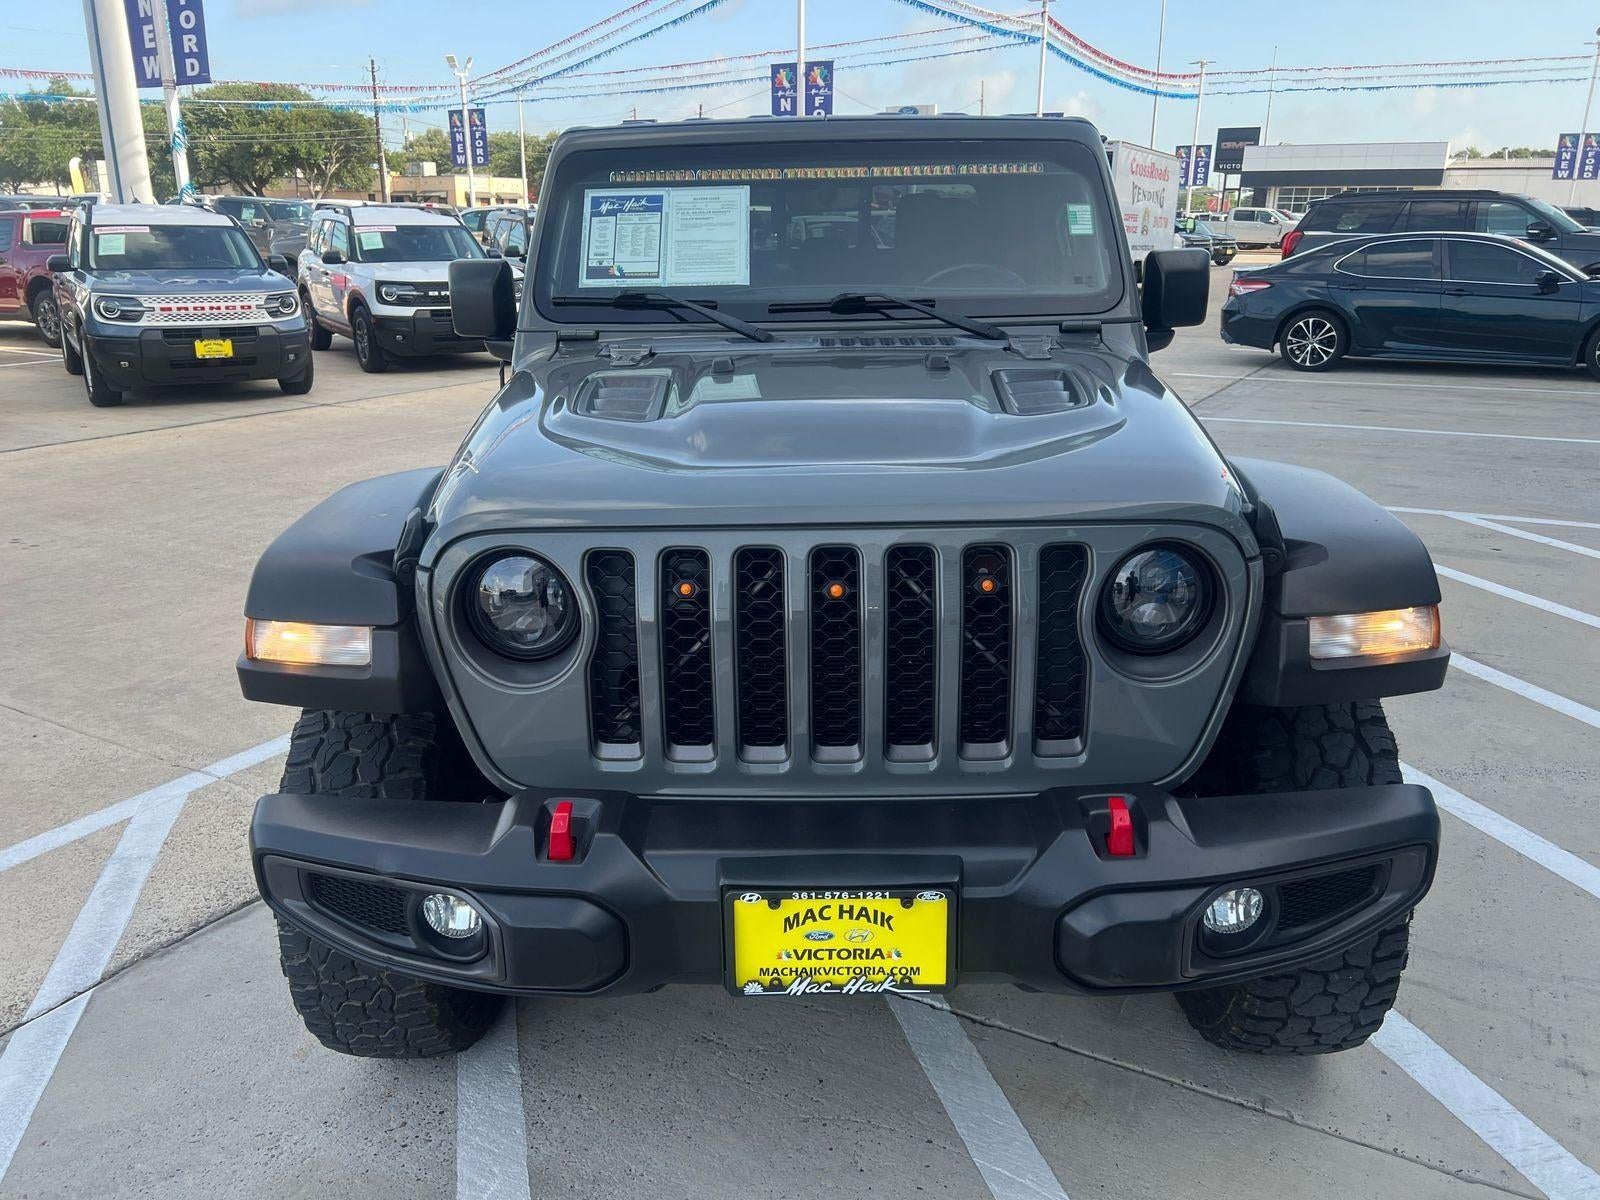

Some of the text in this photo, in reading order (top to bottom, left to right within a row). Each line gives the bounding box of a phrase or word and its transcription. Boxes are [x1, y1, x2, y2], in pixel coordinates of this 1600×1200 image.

[180, 0, 199, 76] ORD
[456, 132, 466, 164] NEW
[475, 131, 484, 164] FORD
[1131, 158, 1170, 182] CrossRoads
[1196, 161, 1205, 184] FORD
[1557, 151, 1570, 178] NEW
[1583, 151, 1595, 178] FORD
[623, 197, 648, 212] Haik
[1132, 181, 1165, 208] VENDING
[791, 891, 890, 900] 361-576-1221
[783, 904, 895, 933] MAC HAIK
[793, 948, 885, 960] VICTORIA
[759, 966, 920, 977] MACHAIKVICTORIA.COM
[786, 975, 901, 996] Mac Haik
